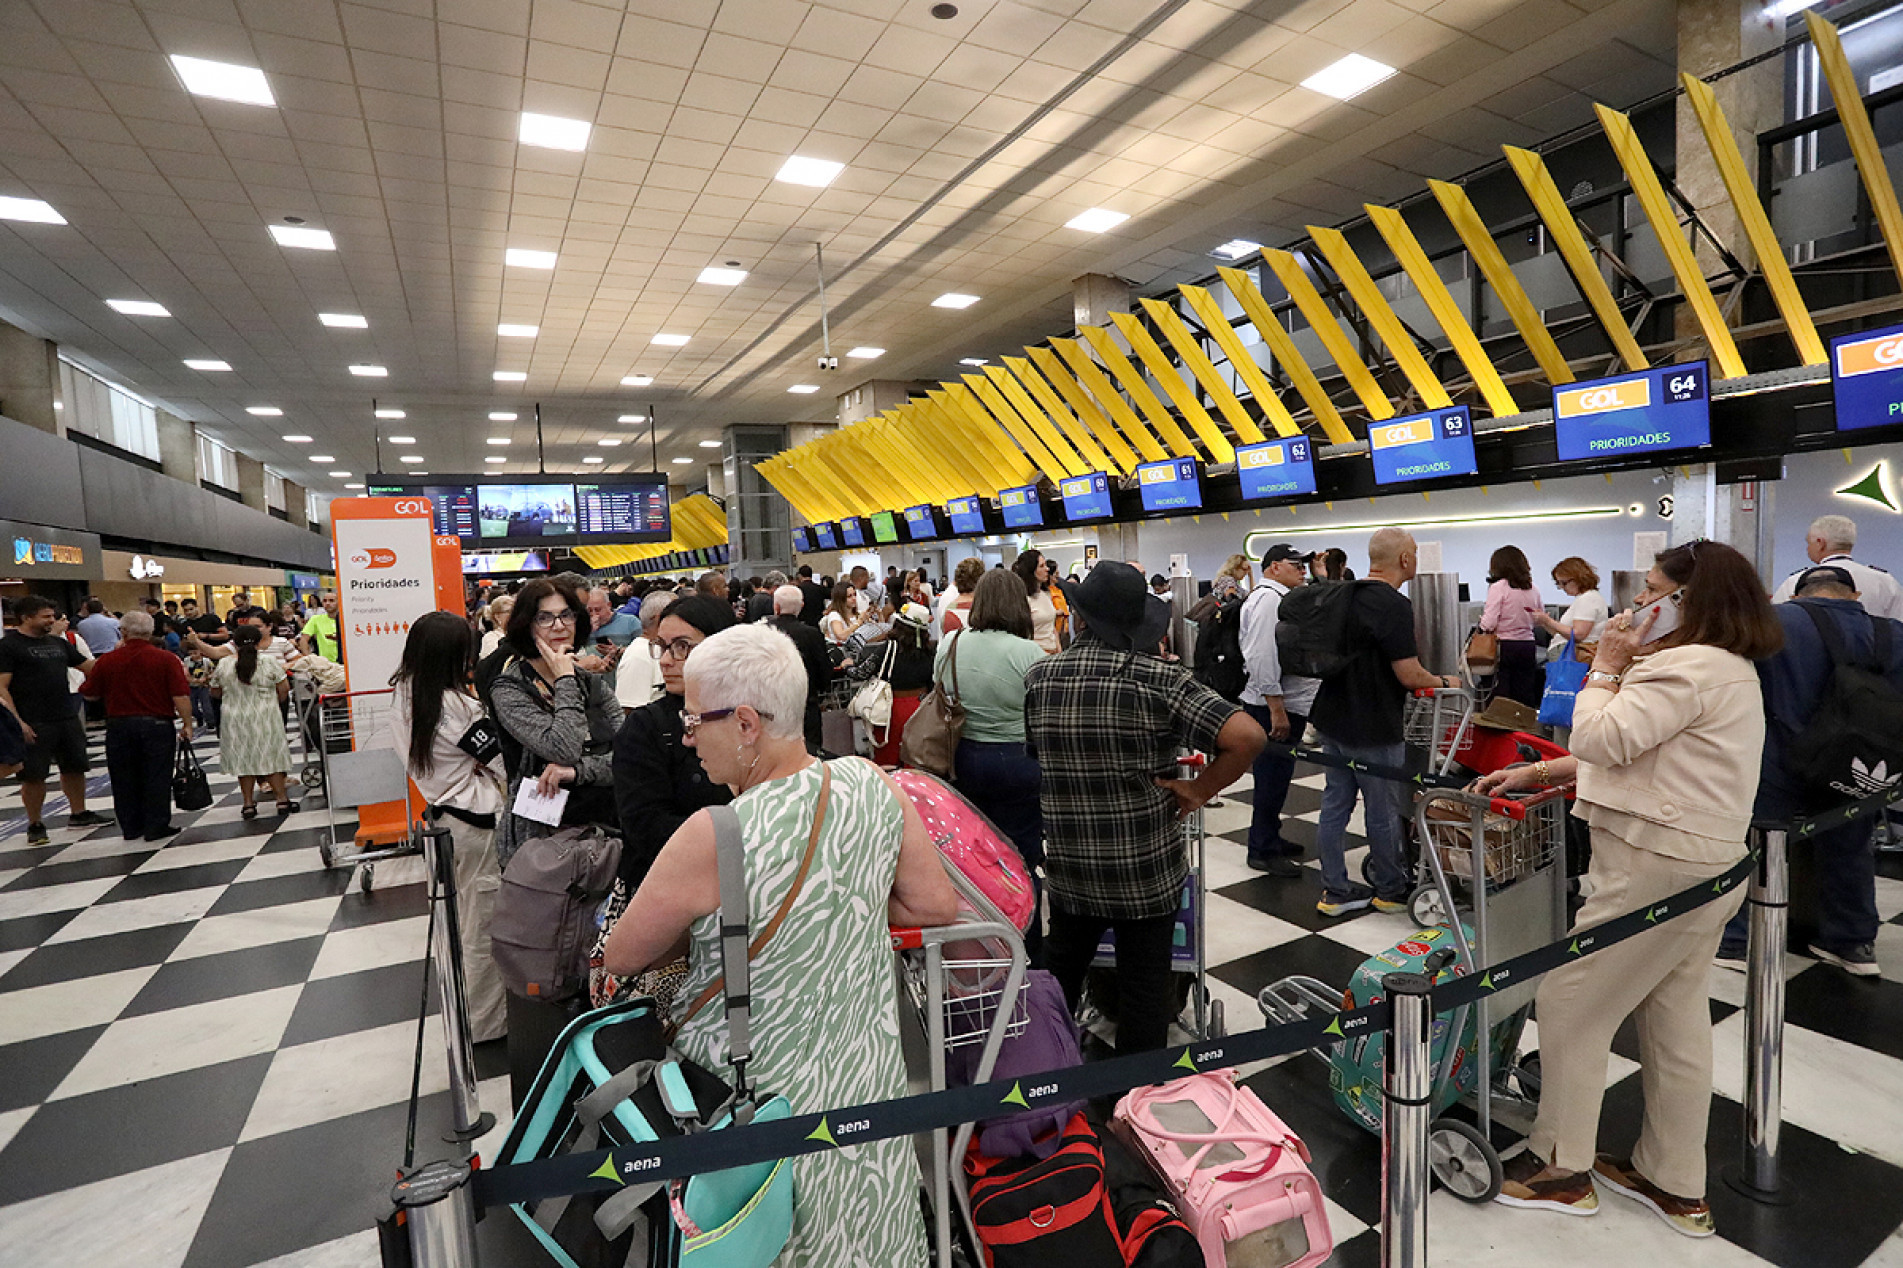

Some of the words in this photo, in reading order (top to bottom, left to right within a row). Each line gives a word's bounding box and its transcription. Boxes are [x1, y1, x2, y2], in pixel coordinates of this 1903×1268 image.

[1669, 375, 1697, 394] 64
[1579, 388, 1625, 410] GOL
[1445, 416, 1463, 431] 63
[1386, 426, 1417, 443] GOL
[1589, 432, 1671, 451] PRIORIDADES
[1291, 443, 1305, 456] 62
[1249, 452, 1272, 465] GOL
[1147, 469, 1167, 481] GOL
[1396, 461, 1452, 477] PRIORIDADES
[394, 501, 429, 514] GOL
[436, 537, 458, 546] GOL
[350, 578, 420, 590] Prioridades
[470, 728, 489, 748] 18
[1344, 1016, 1368, 1029] aena
[1196, 1048, 1224, 1063] aena
[1028, 1082, 1058, 1098] aena
[836, 1119, 870, 1135] aena
[624, 1155, 661, 1173] aena
